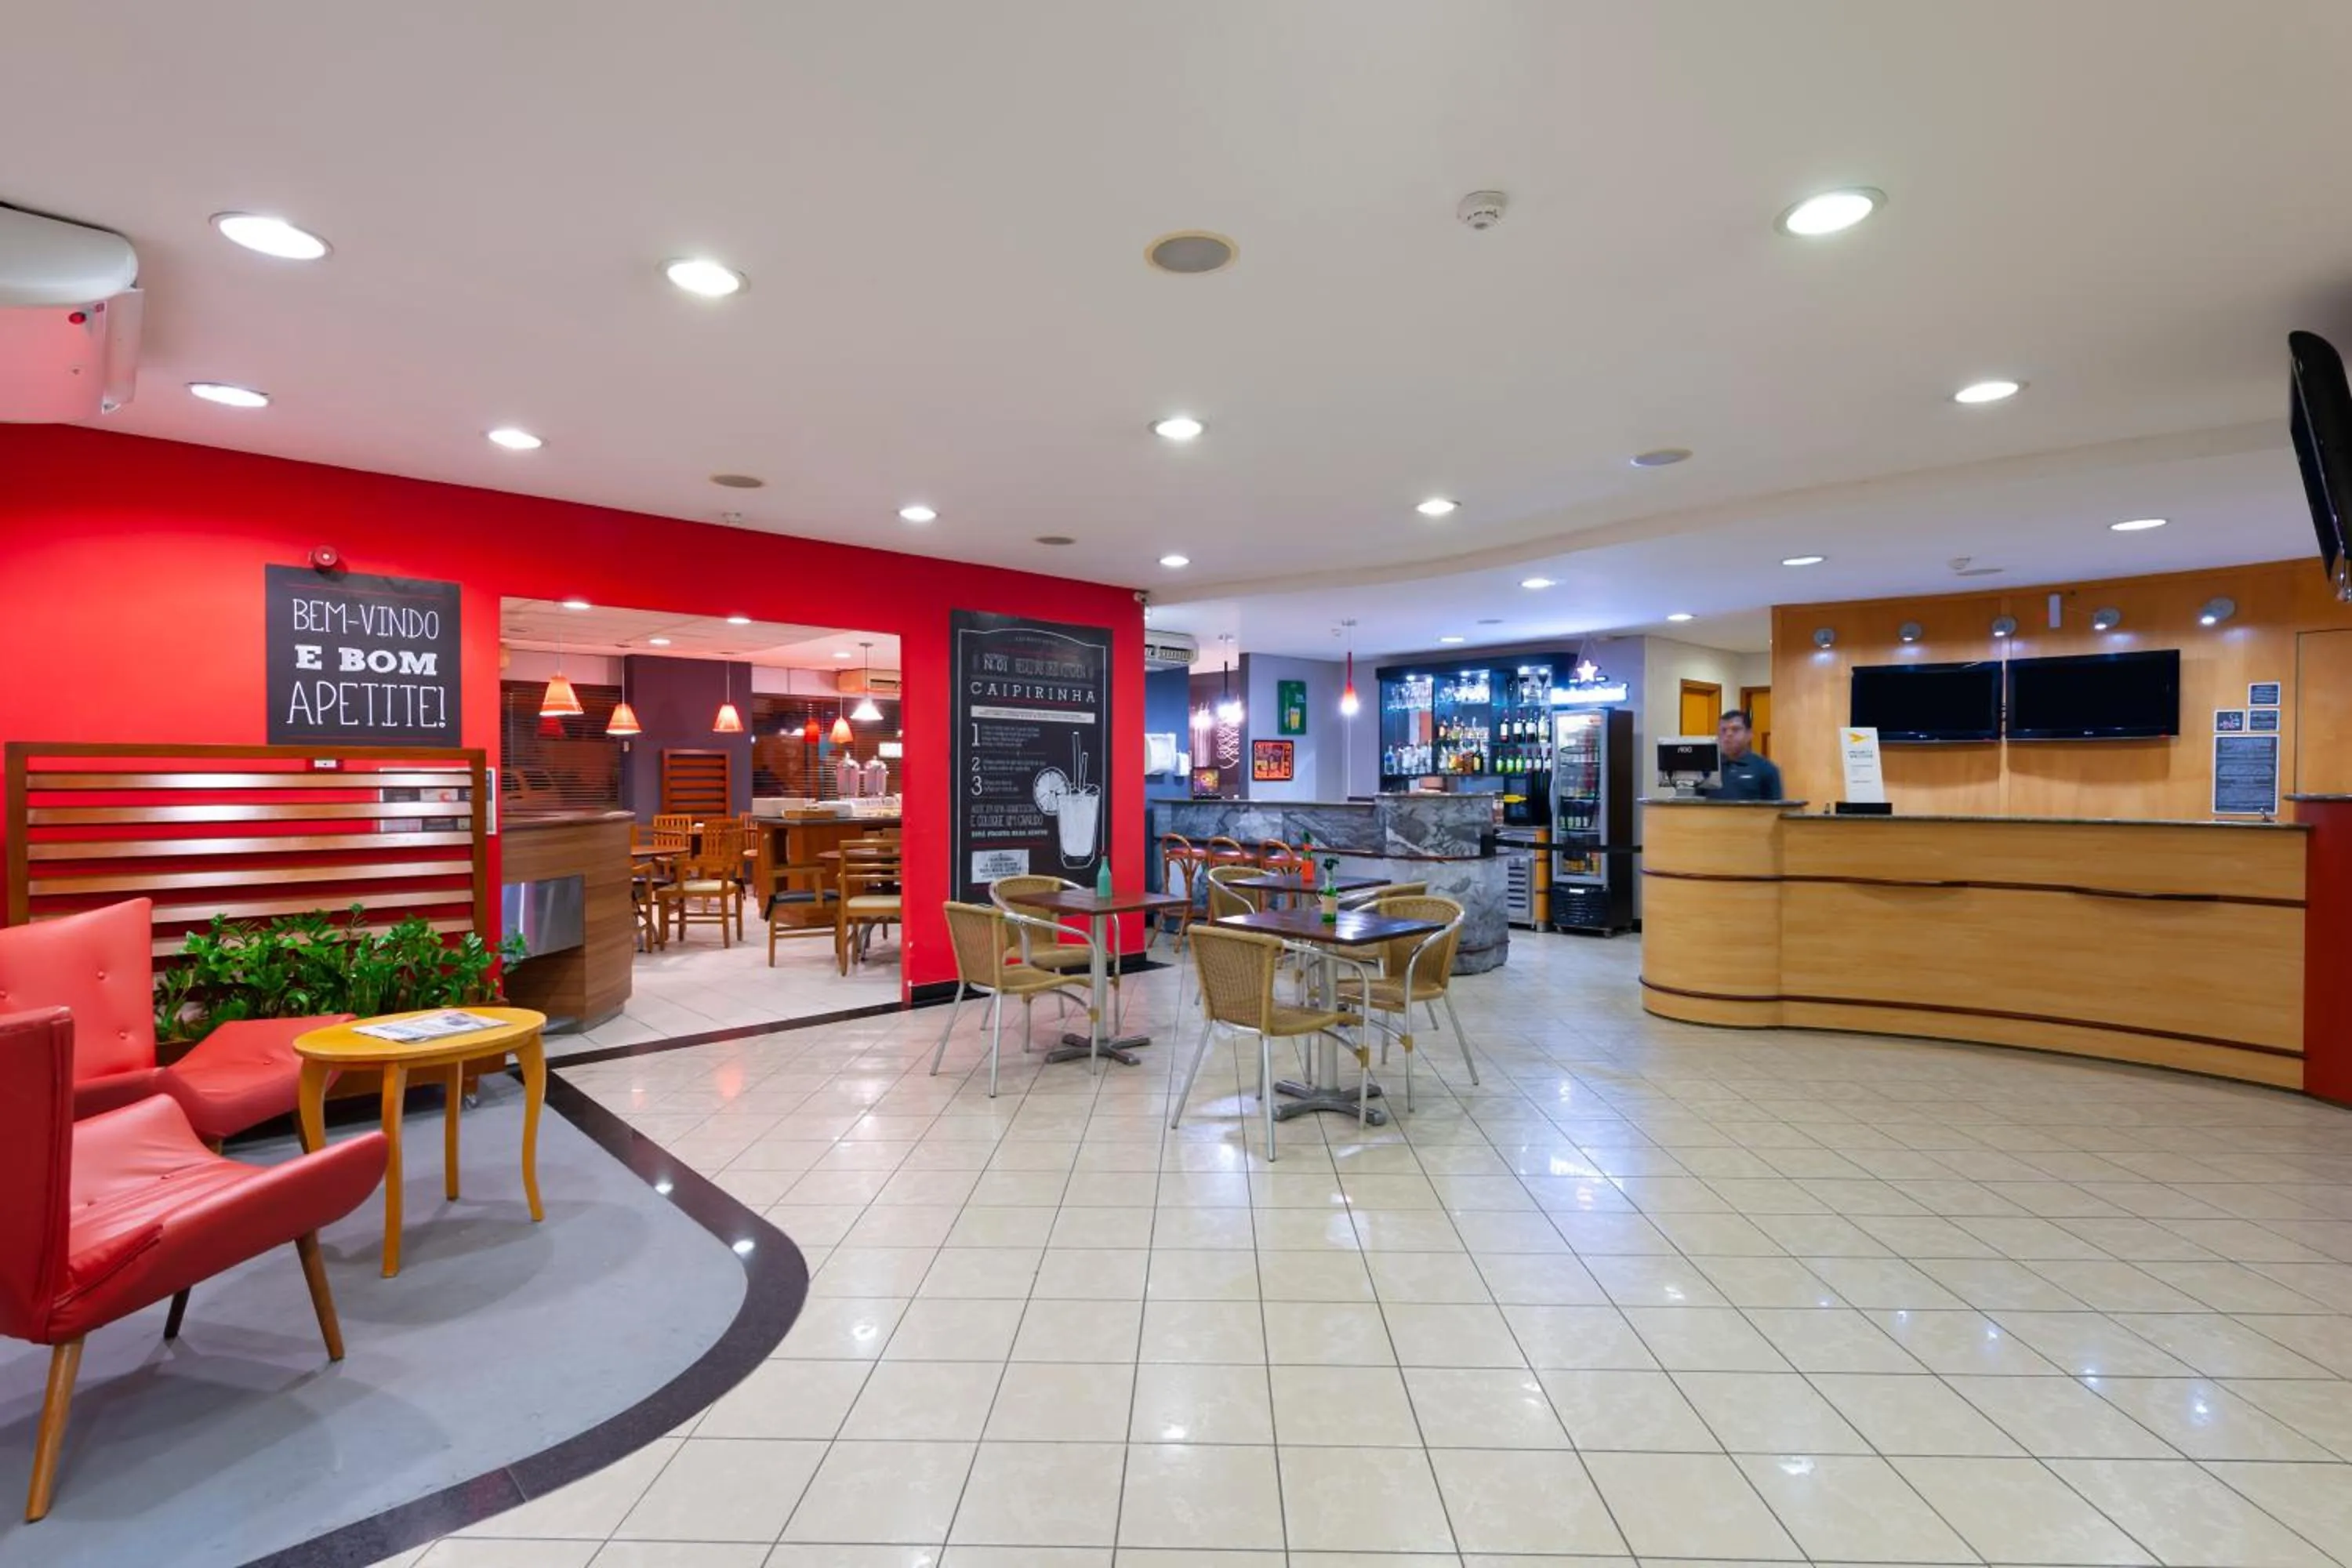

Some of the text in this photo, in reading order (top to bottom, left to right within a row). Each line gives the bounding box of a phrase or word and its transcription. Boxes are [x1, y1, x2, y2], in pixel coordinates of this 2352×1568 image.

[292, 598, 439, 640] BEM-VINDO
[295, 644, 437, 676] E BOM
[286, 681, 446, 728] APETITE!
[970, 681, 1096, 703] CAIPIRINHA
[971, 722, 981, 747] 1
[971, 757, 981, 772] 2
[970, 775, 983, 797] 3
